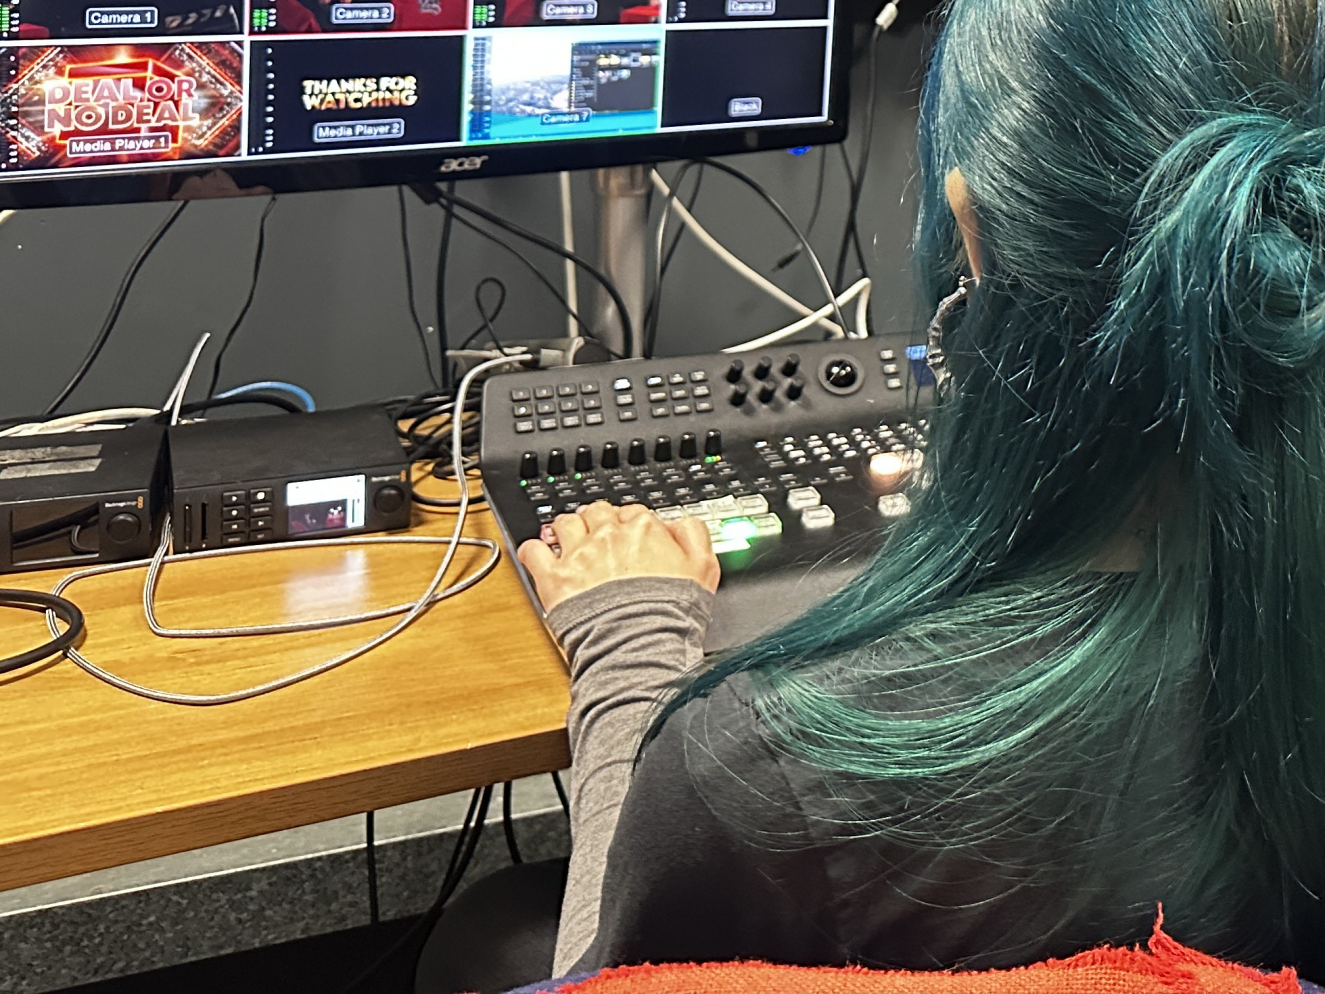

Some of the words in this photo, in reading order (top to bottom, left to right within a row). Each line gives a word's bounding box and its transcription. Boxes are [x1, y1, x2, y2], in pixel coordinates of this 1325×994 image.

[91, 12, 141, 24] Camera
[145, 11, 151, 23] 1
[336, 8, 380, 19] Camera
[382, 7, 390, 19] 2
[547, 4, 584, 15] Camera
[45, 78, 140, 106] DEAL
[147, 77, 197, 101] OR
[302, 78, 377, 94] THANKS
[380, 76, 417, 91] FOR
[302, 90, 418, 110] WATCHING
[45, 104, 105, 131] NO
[109, 101, 200, 129] DEAL
[542, 113, 580, 124] Camera
[582, 111, 589, 122] 7
[319, 127, 353, 138] Media
[355, 124, 390, 136] Player
[392, 123, 400, 133] 2
[72, 141, 111, 153] Media
[115, 138, 155, 151] Player
[160, 137, 165, 147] 1
[440, 155, 489, 172] acer
